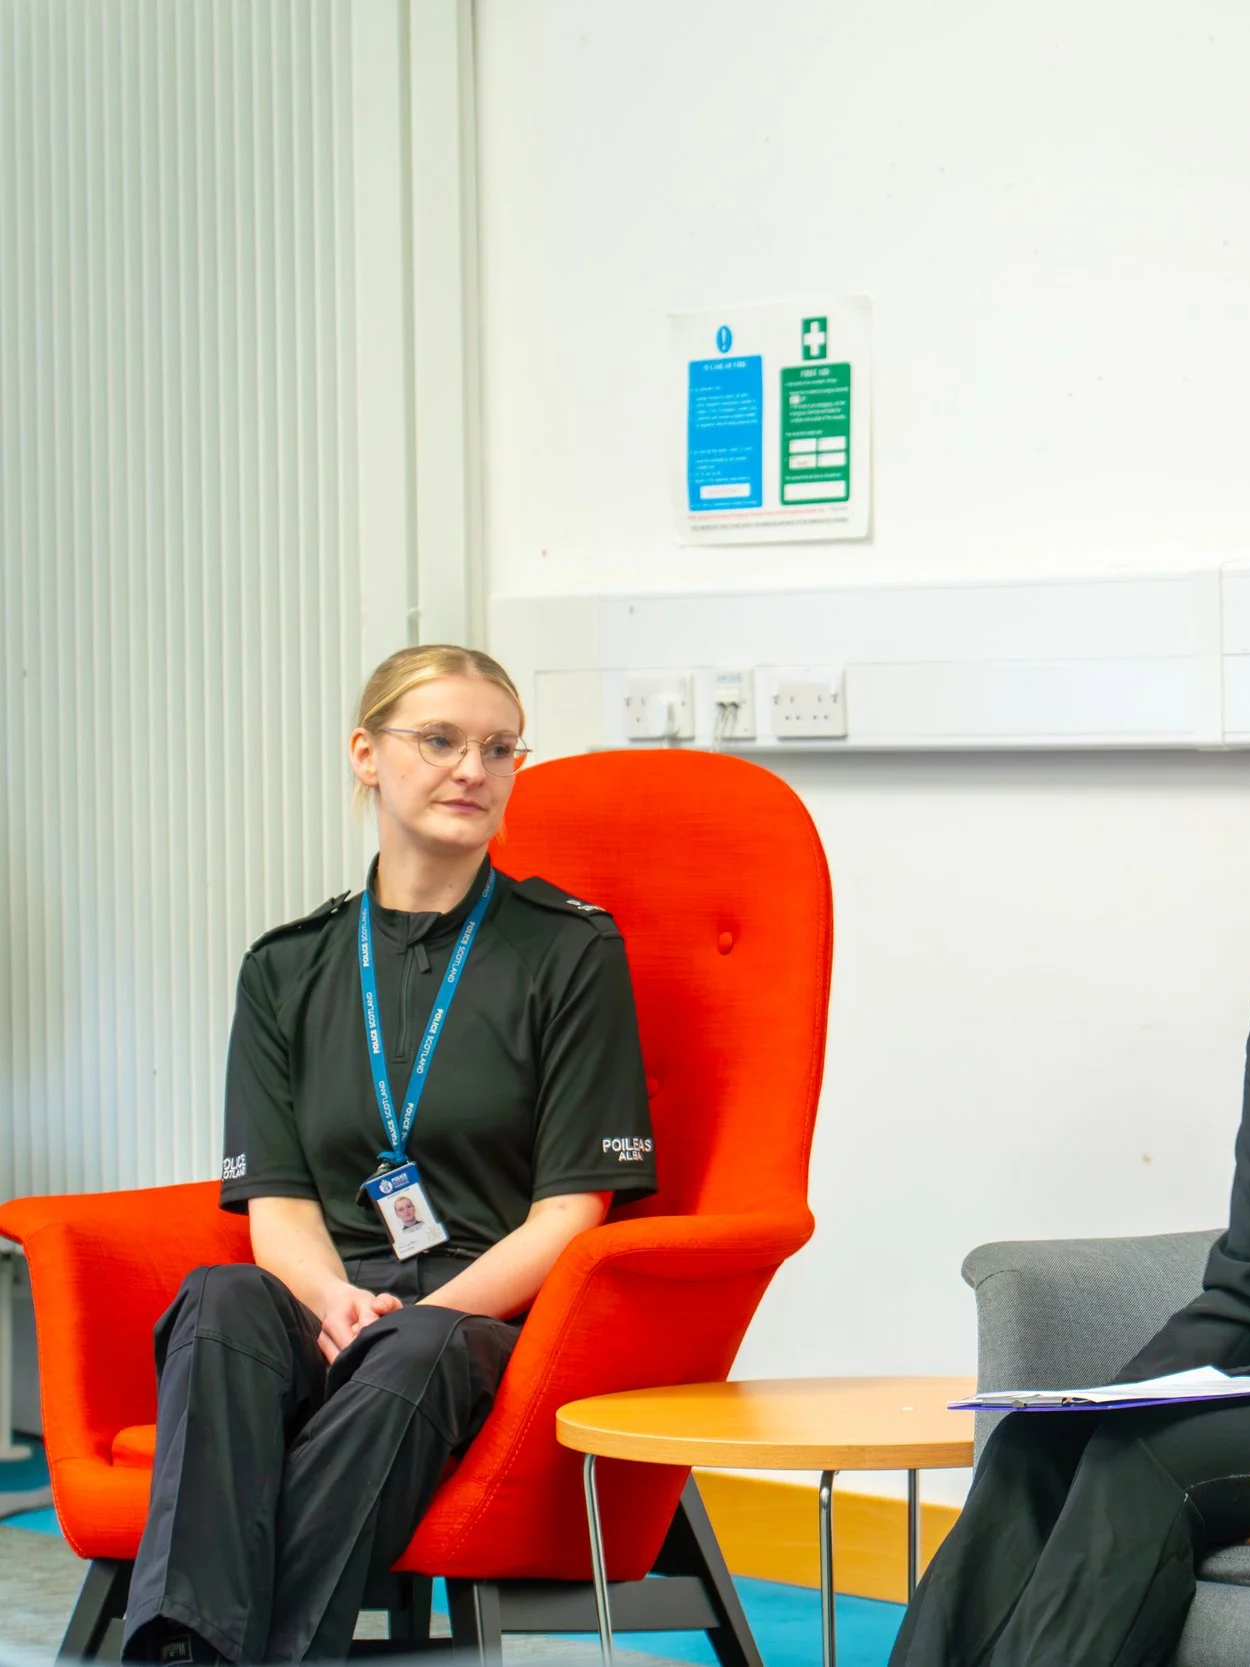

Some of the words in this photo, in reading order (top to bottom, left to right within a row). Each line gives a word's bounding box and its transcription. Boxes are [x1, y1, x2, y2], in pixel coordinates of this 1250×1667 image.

[461, 921, 476, 945] POLICE
[447, 945, 466, 984] SCOTLAND
[366, 991, 377, 1029] SCOTLAND
[429, 1007, 444, 1034] POLICE
[371, 1029, 381, 1055] POLICE
[416, 1035, 435, 1074] SCOTLAND
[379, 1080, 392, 1119] SCOTLAND
[402, 1102, 415, 1130] POLICE
[387, 1119, 398, 1146] POLICE
[602, 1138, 652, 1153] POILEAS
[223, 1153, 247, 1171] OLICE
[618, 1150, 644, 1162] ALBA
